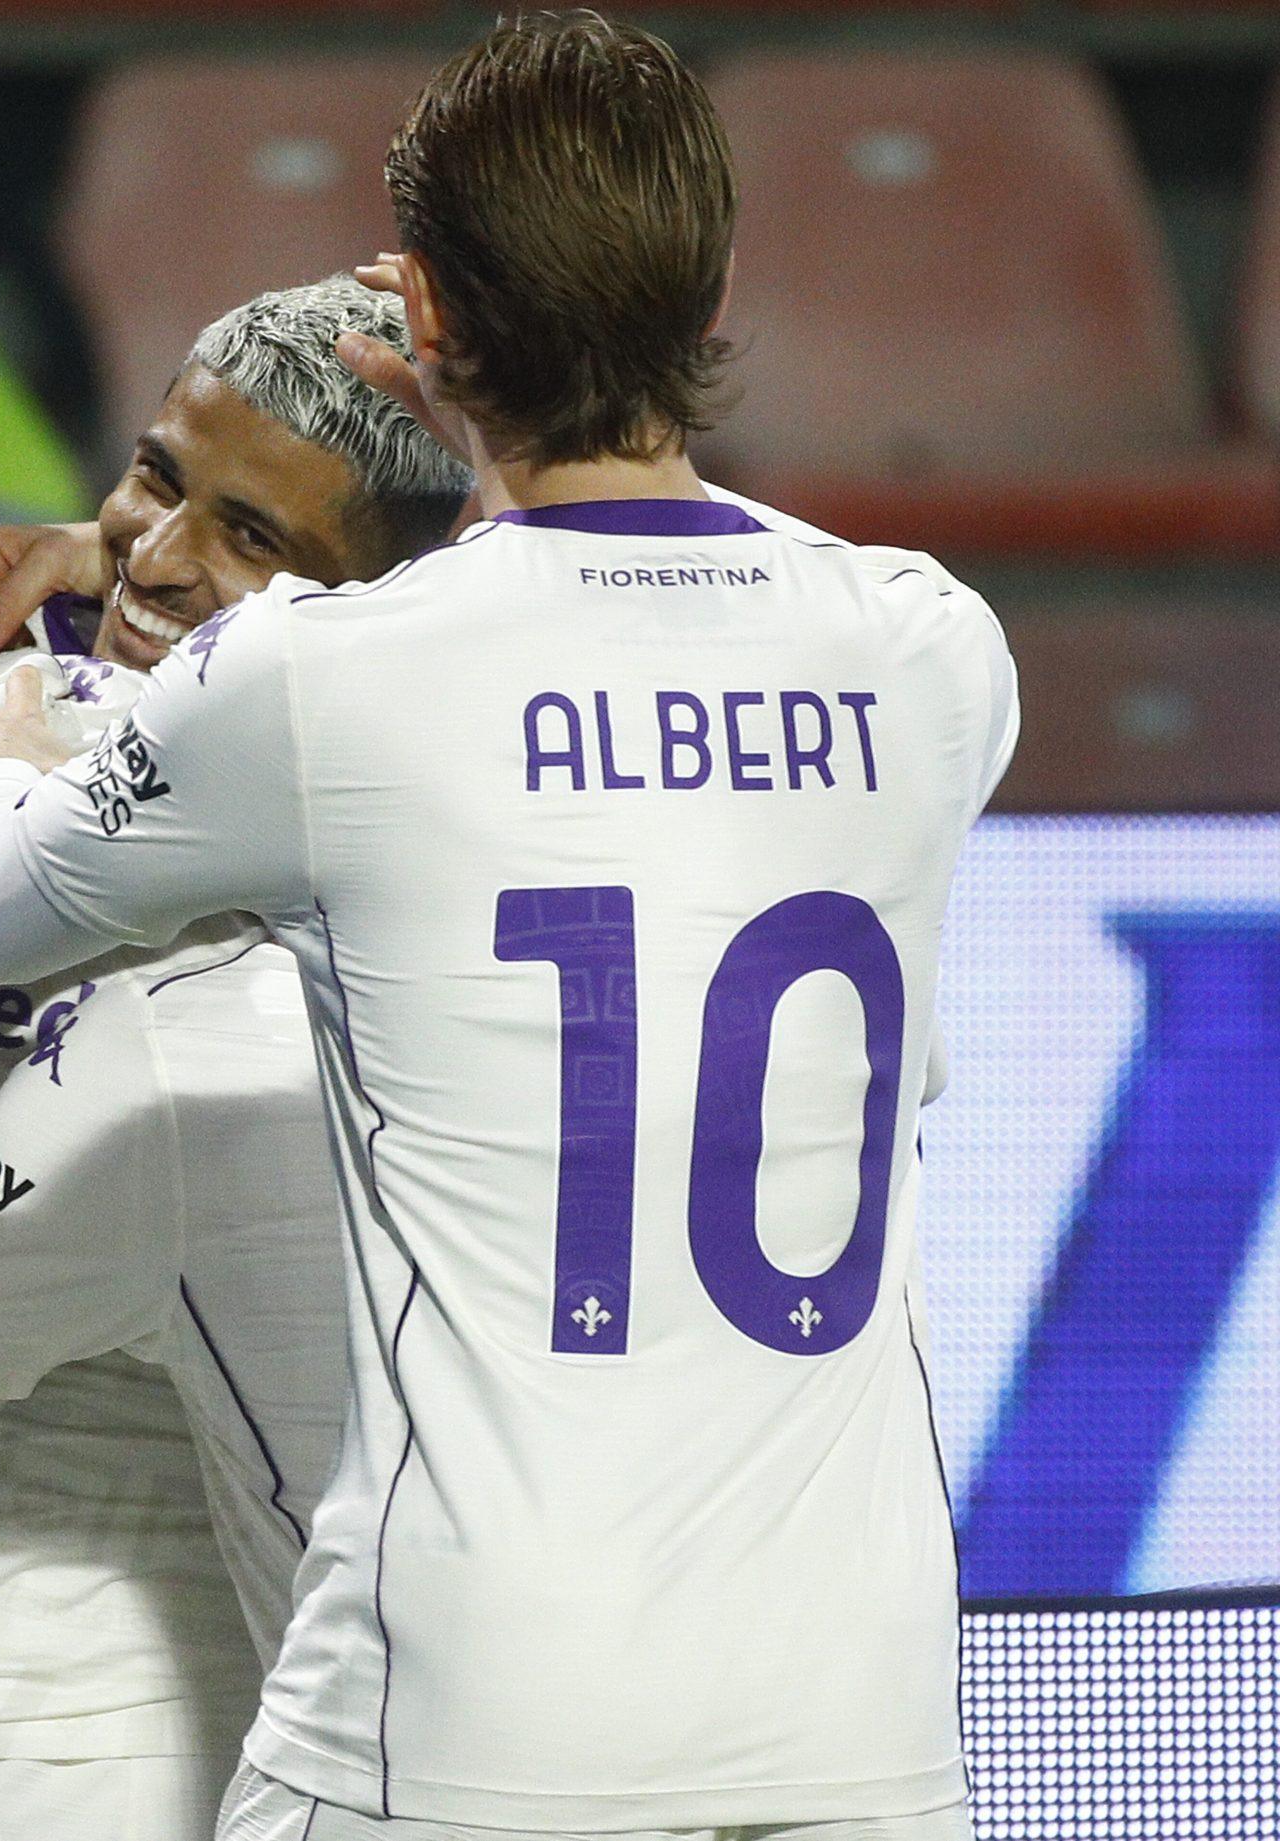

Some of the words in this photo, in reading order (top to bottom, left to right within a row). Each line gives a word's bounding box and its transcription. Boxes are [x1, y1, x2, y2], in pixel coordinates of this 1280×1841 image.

[580, 567, 770, 587] FIORENTINA
[523, 690, 878, 792] ALBERT
[493, 886, 905, 1356] 10
